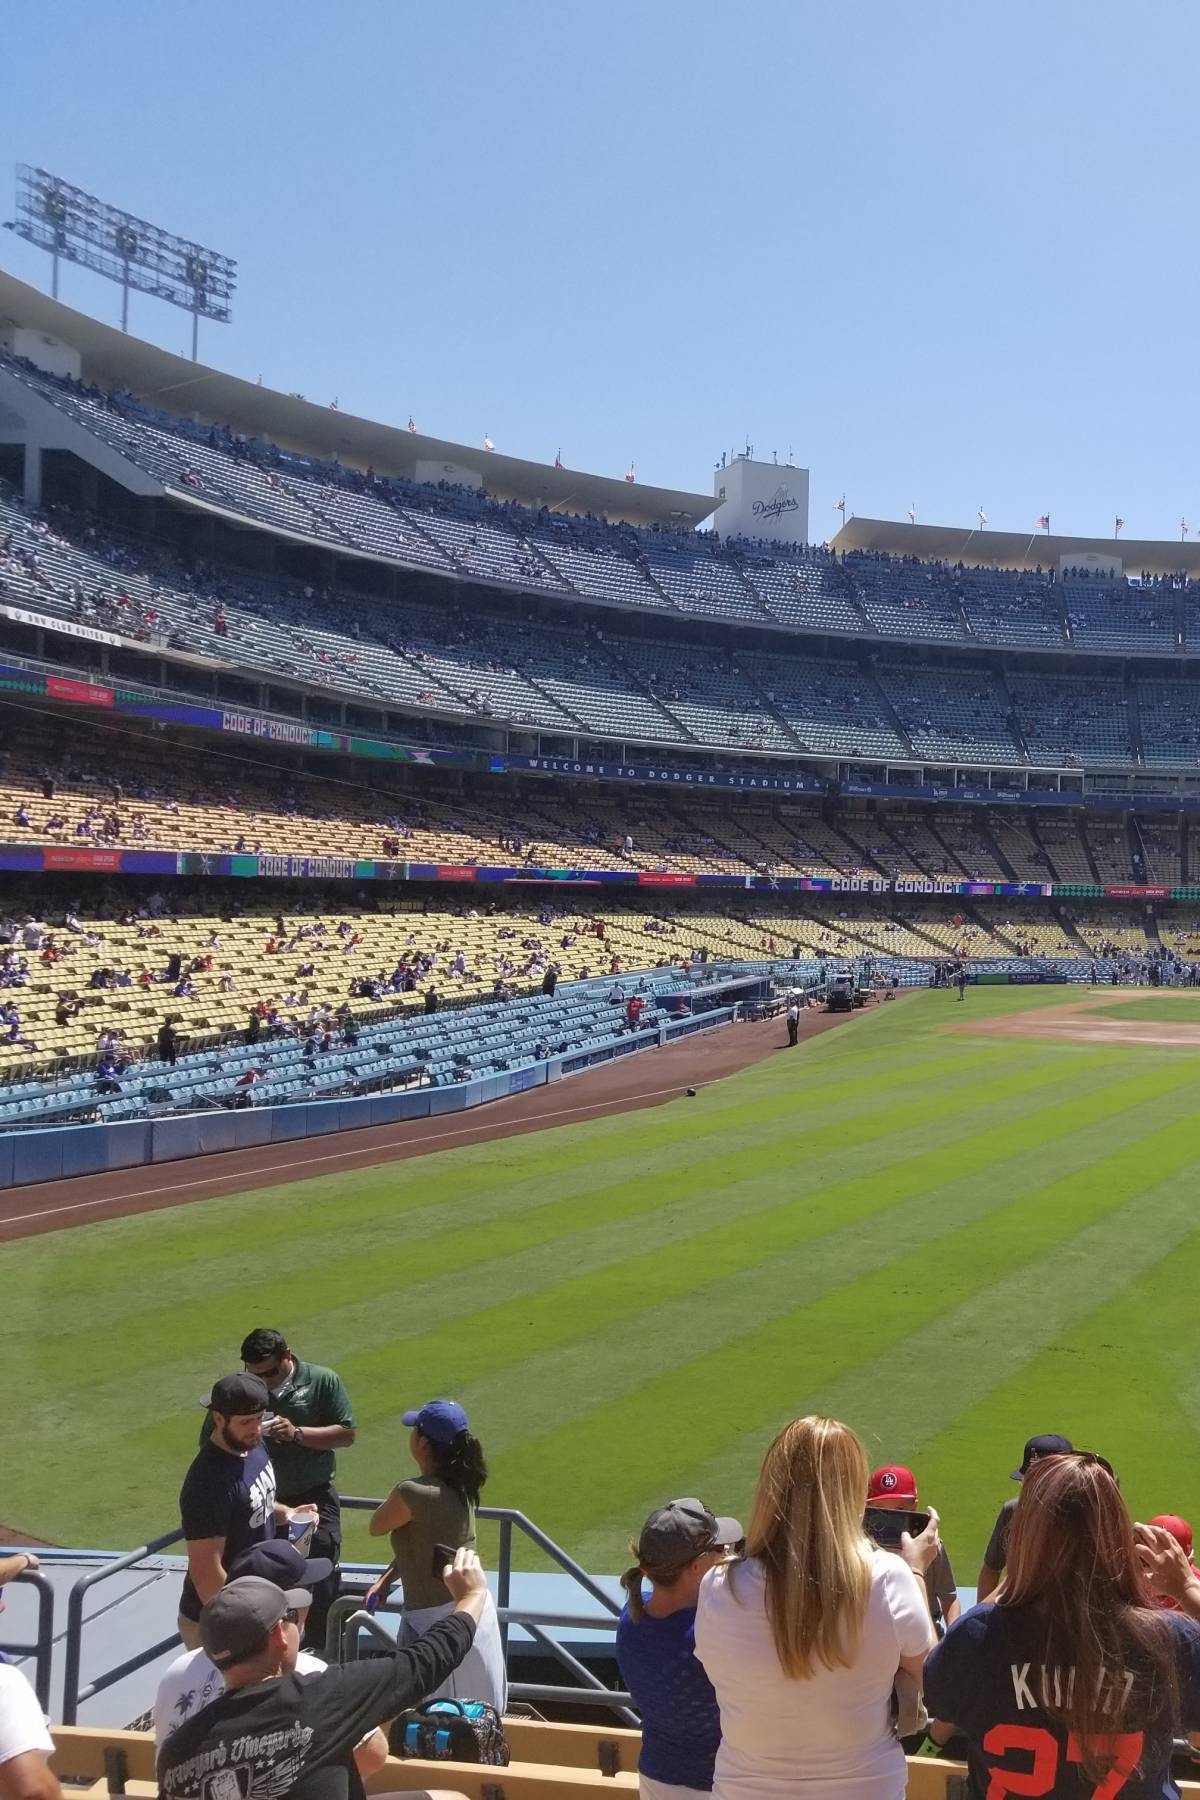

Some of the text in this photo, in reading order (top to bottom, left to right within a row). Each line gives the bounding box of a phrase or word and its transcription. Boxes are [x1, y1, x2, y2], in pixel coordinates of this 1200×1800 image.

[753, 498, 799, 518] Dodgers
[223, 712, 314, 745] CODE OF CONDUCT
[529, 760, 804, 789] WELCOME TO DODGER STADIUM
[258, 856, 355, 878] CODE OF CONDUCT
[832, 879, 961, 893] CODE OF CONDUCT
[984, 1723, 1145, 1800] 27
